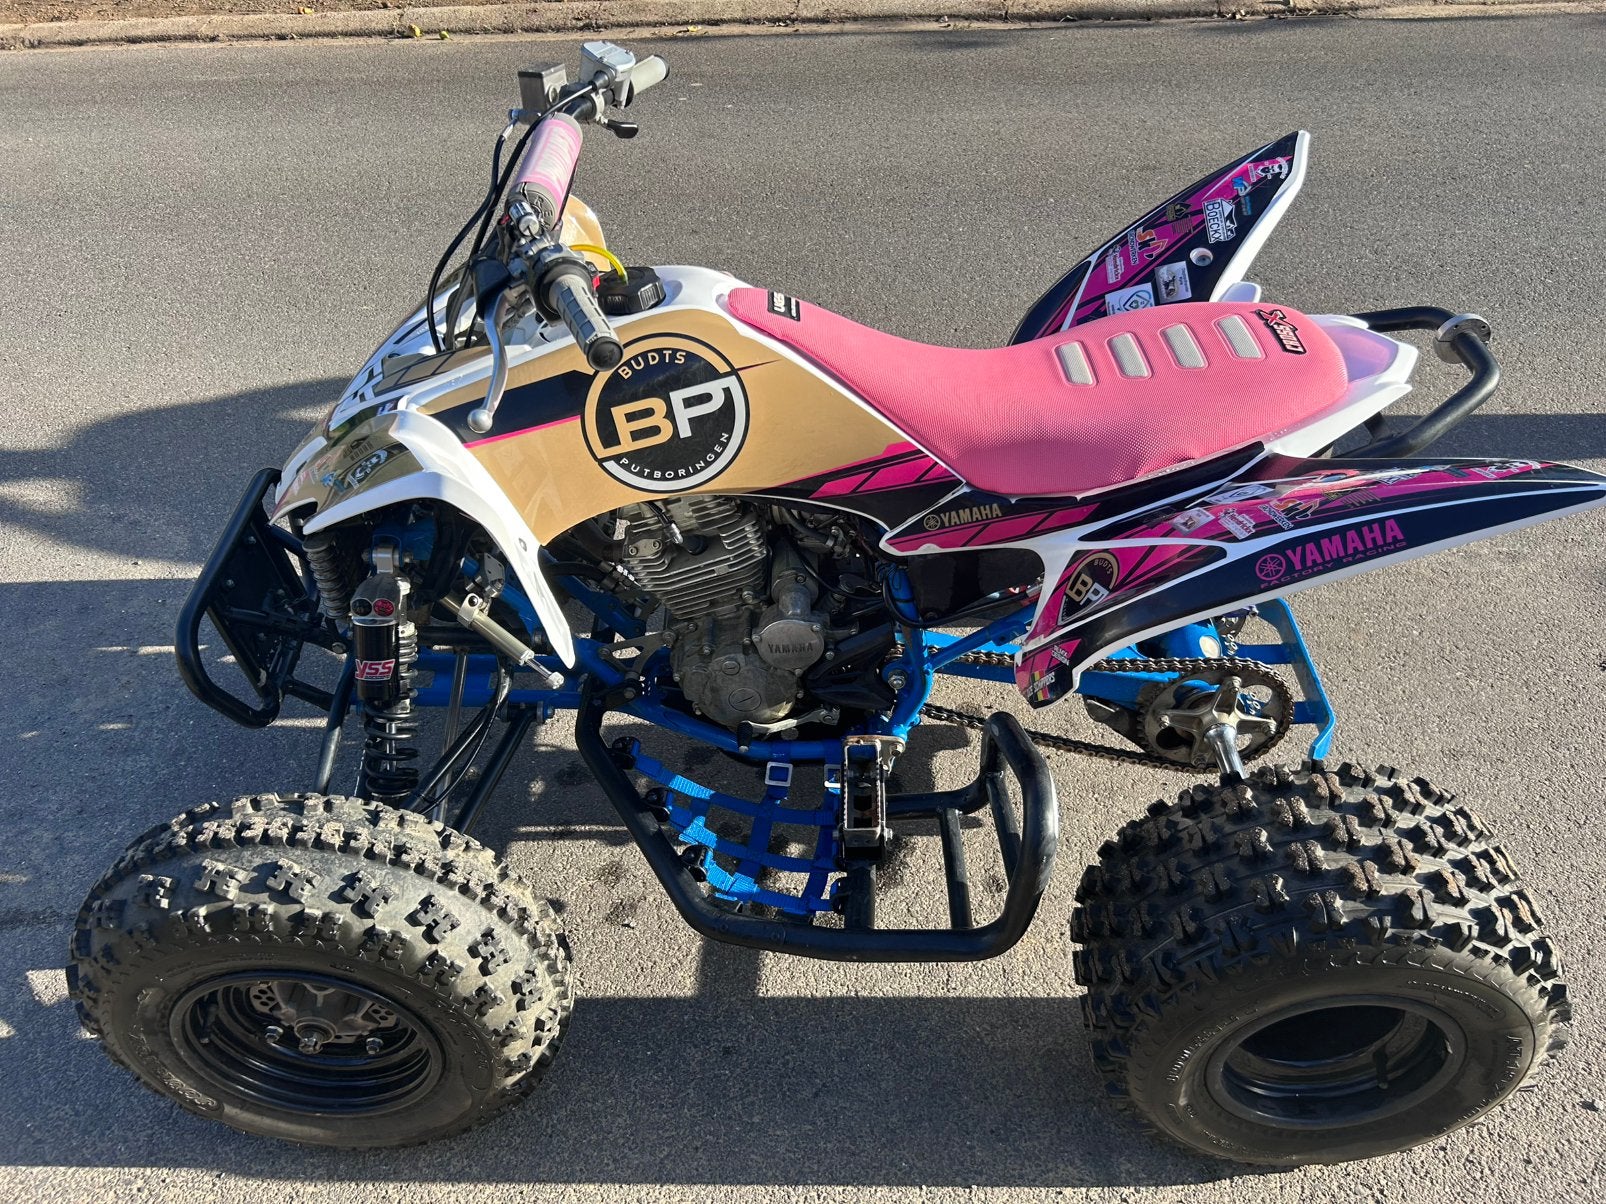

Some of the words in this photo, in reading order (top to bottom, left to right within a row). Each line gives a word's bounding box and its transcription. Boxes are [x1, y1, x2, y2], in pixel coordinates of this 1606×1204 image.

[1205, 201, 1224, 243] BOECKX
[618, 350, 687, 380] BUDTS
[610, 376, 728, 455] BP
[619, 432, 730, 479] PUTBORINGEN
[940, 503, 1003, 527] YAMAHA
[1285, 518, 1405, 571] YAMAHA
[1093, 559, 1112, 576] BUDTS
[1259, 562, 1335, 590] FACTORY
[1342, 541, 1408, 564] RACING
[1066, 573, 1109, 606] BP
[768, 642, 813, 655] YAMAHA
[355, 659, 395, 681] YSS
